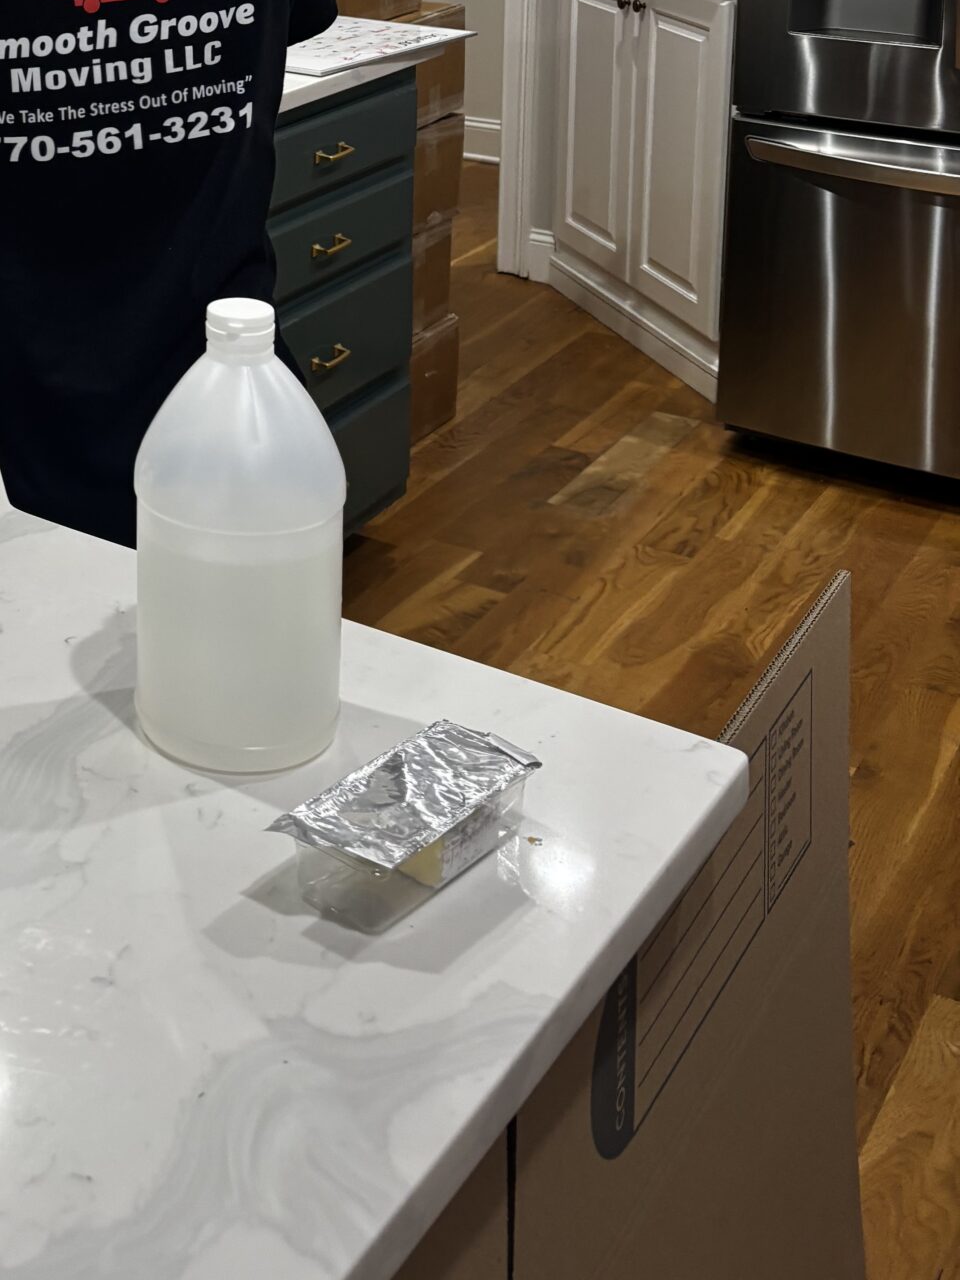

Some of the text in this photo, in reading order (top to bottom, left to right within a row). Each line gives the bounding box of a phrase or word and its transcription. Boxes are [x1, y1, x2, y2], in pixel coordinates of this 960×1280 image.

[128, 2, 255, 45] Groove
[10, 40, 222, 94] Moving LLC
[19, 108, 54, 124] Take
[58, 104, 86, 122] The
[90, 100, 135, 117] Stress
[139, 93, 168, 110] Out
[172, 88, 189, 105] Of
[192, 74, 252, 100] Moving”
[616, 974, 628, 1132] CONTENTS
